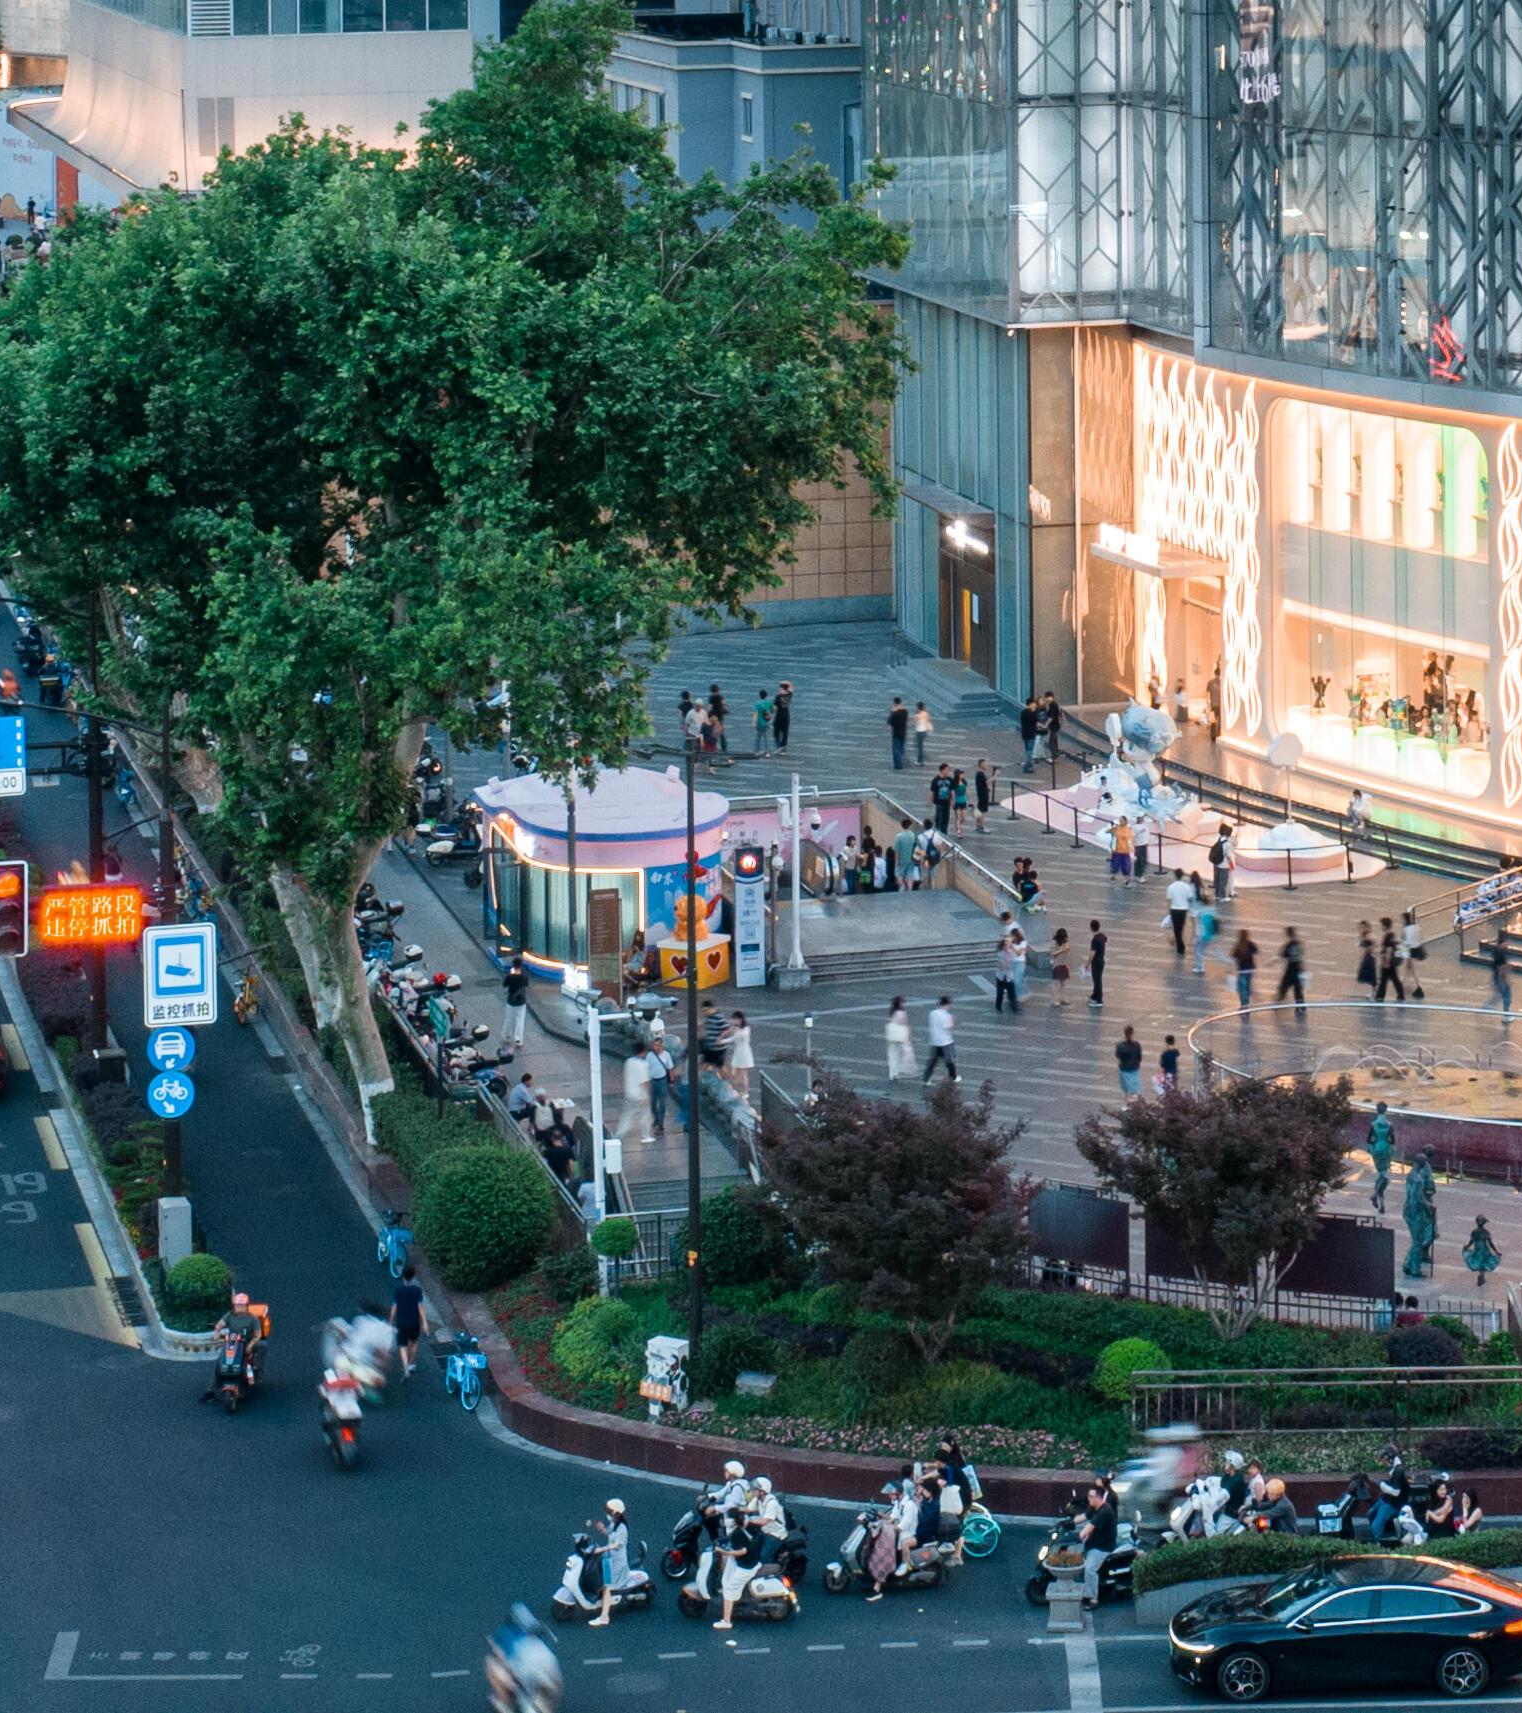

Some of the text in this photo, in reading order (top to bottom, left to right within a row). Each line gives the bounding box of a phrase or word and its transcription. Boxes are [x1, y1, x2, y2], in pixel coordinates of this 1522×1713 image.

[45, 894, 138, 918] 严管路段
[44, 916, 137, 938] 违停抓拍
[152, 1001, 210, 1021] 监控抓拍
